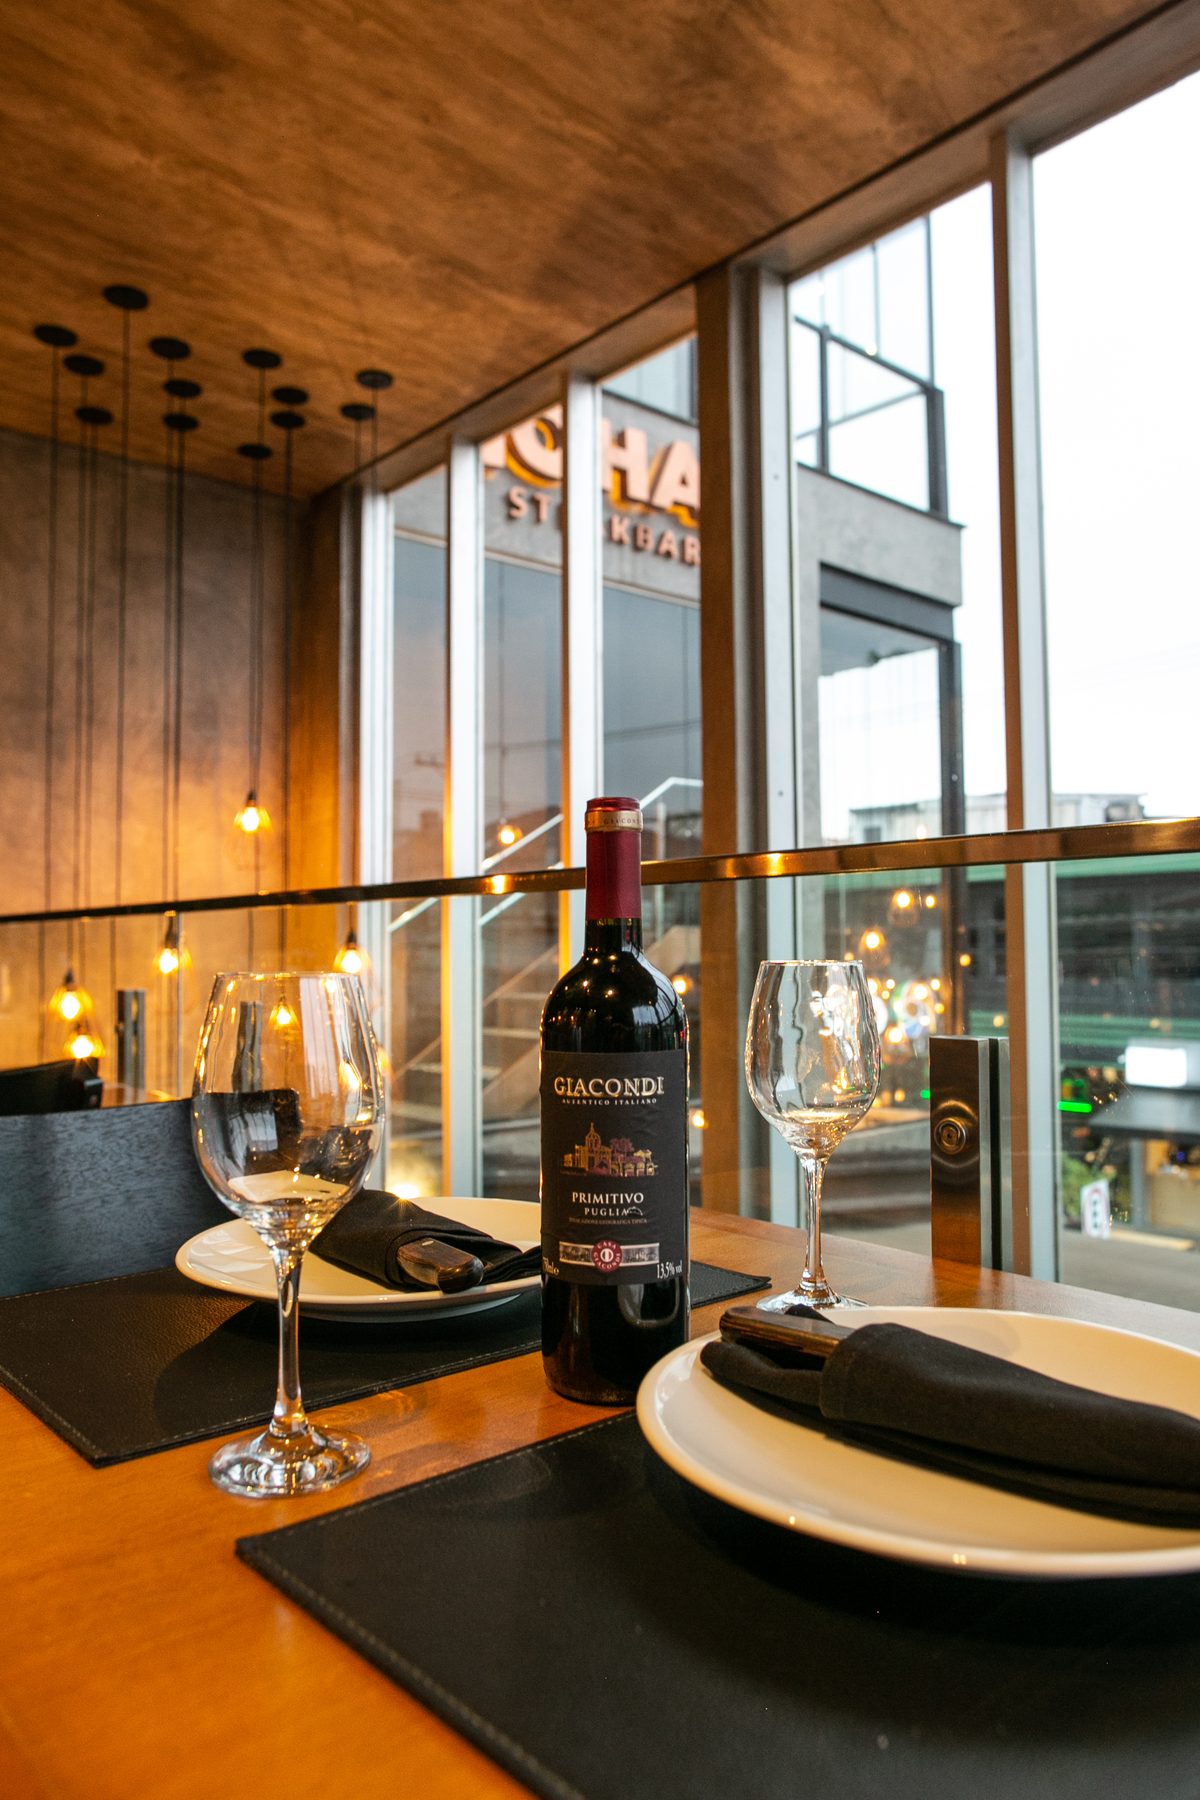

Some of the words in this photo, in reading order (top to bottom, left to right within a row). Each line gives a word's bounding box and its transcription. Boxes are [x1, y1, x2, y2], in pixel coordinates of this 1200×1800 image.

[507, 485, 700, 566] STKBAR
[554, 1076, 665, 1097] GIACONDI
[562, 1098, 610, 1106] AUTENTICO
[614, 1098, 657, 1106] ITALIANO
[572, 1192, 644, 1204] PRIMITIVO
[584, 1207, 628, 1216] PUGLIA
[597, 1241, 617, 1250] CASA
